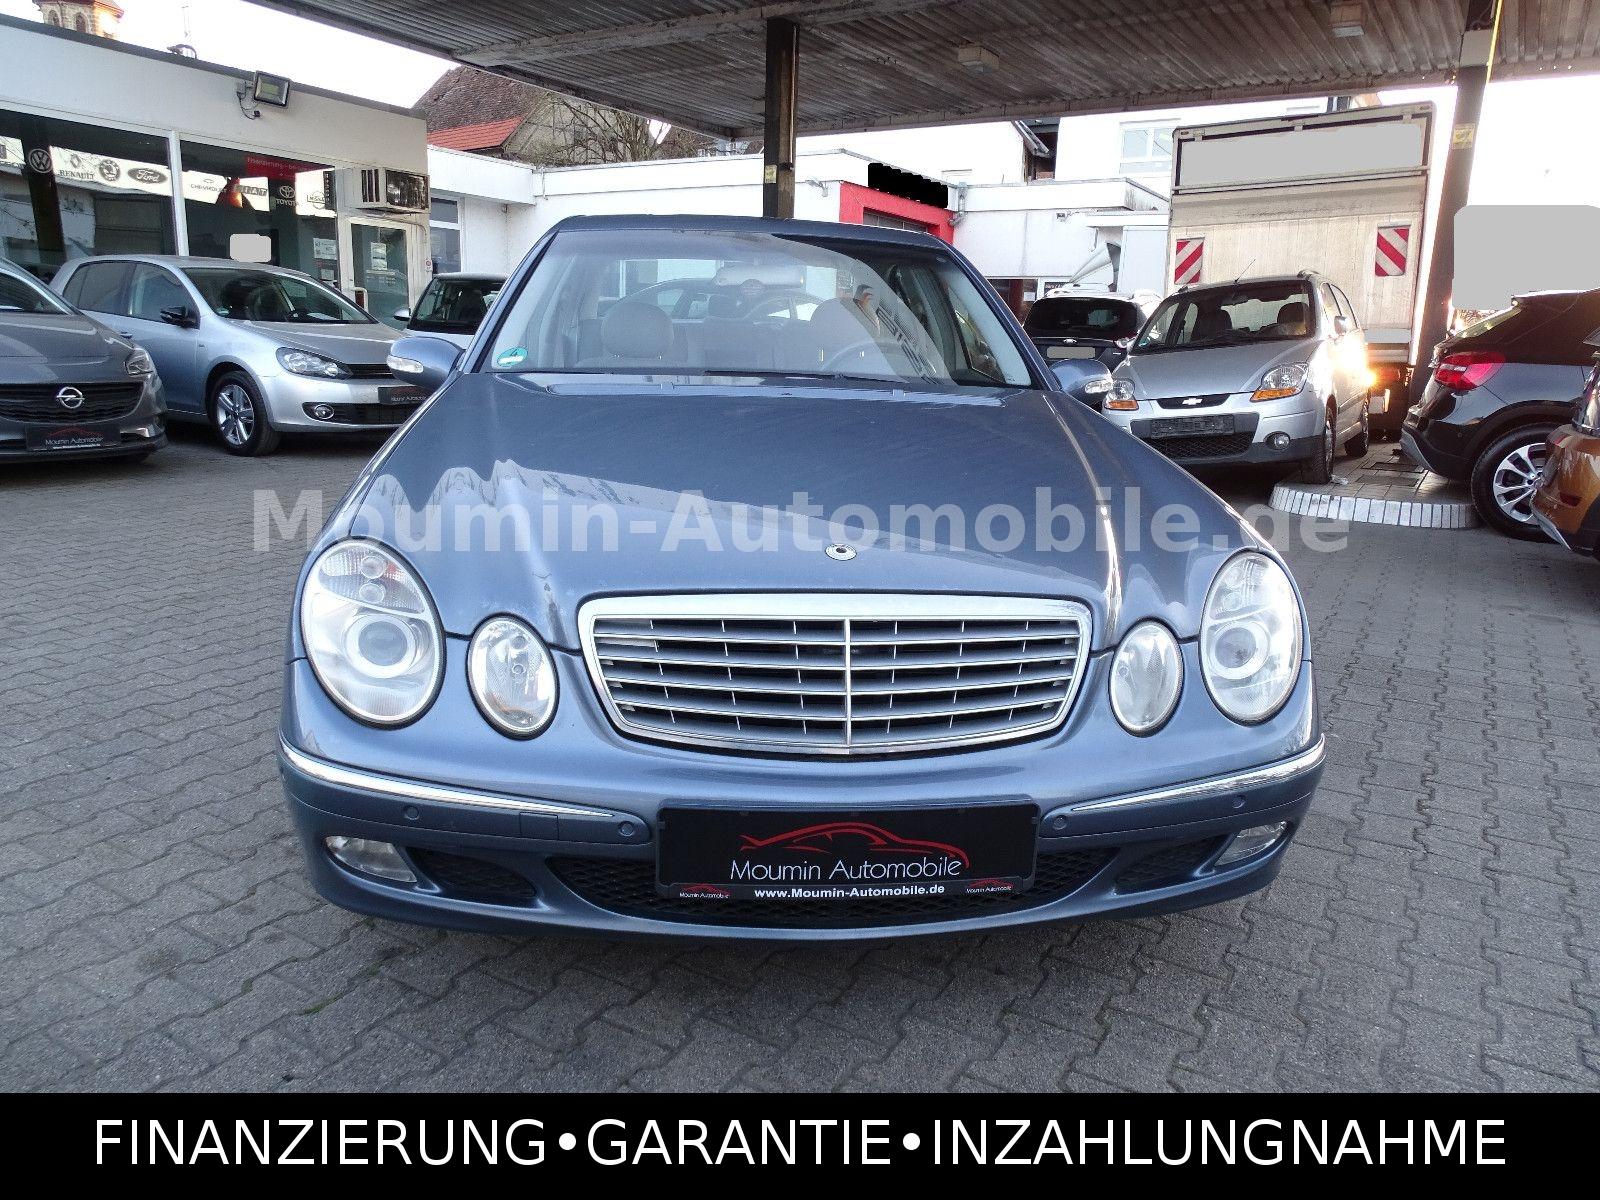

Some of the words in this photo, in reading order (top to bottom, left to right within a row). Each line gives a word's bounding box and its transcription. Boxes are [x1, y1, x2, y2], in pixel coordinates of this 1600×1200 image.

[59, 169, 95, 180] RENAULT
[730, 859, 821, 881] Moumin
[828, 856, 962, 880] Automobile
[754, 884, 945, 899] www.Moumin-Automobile.de
